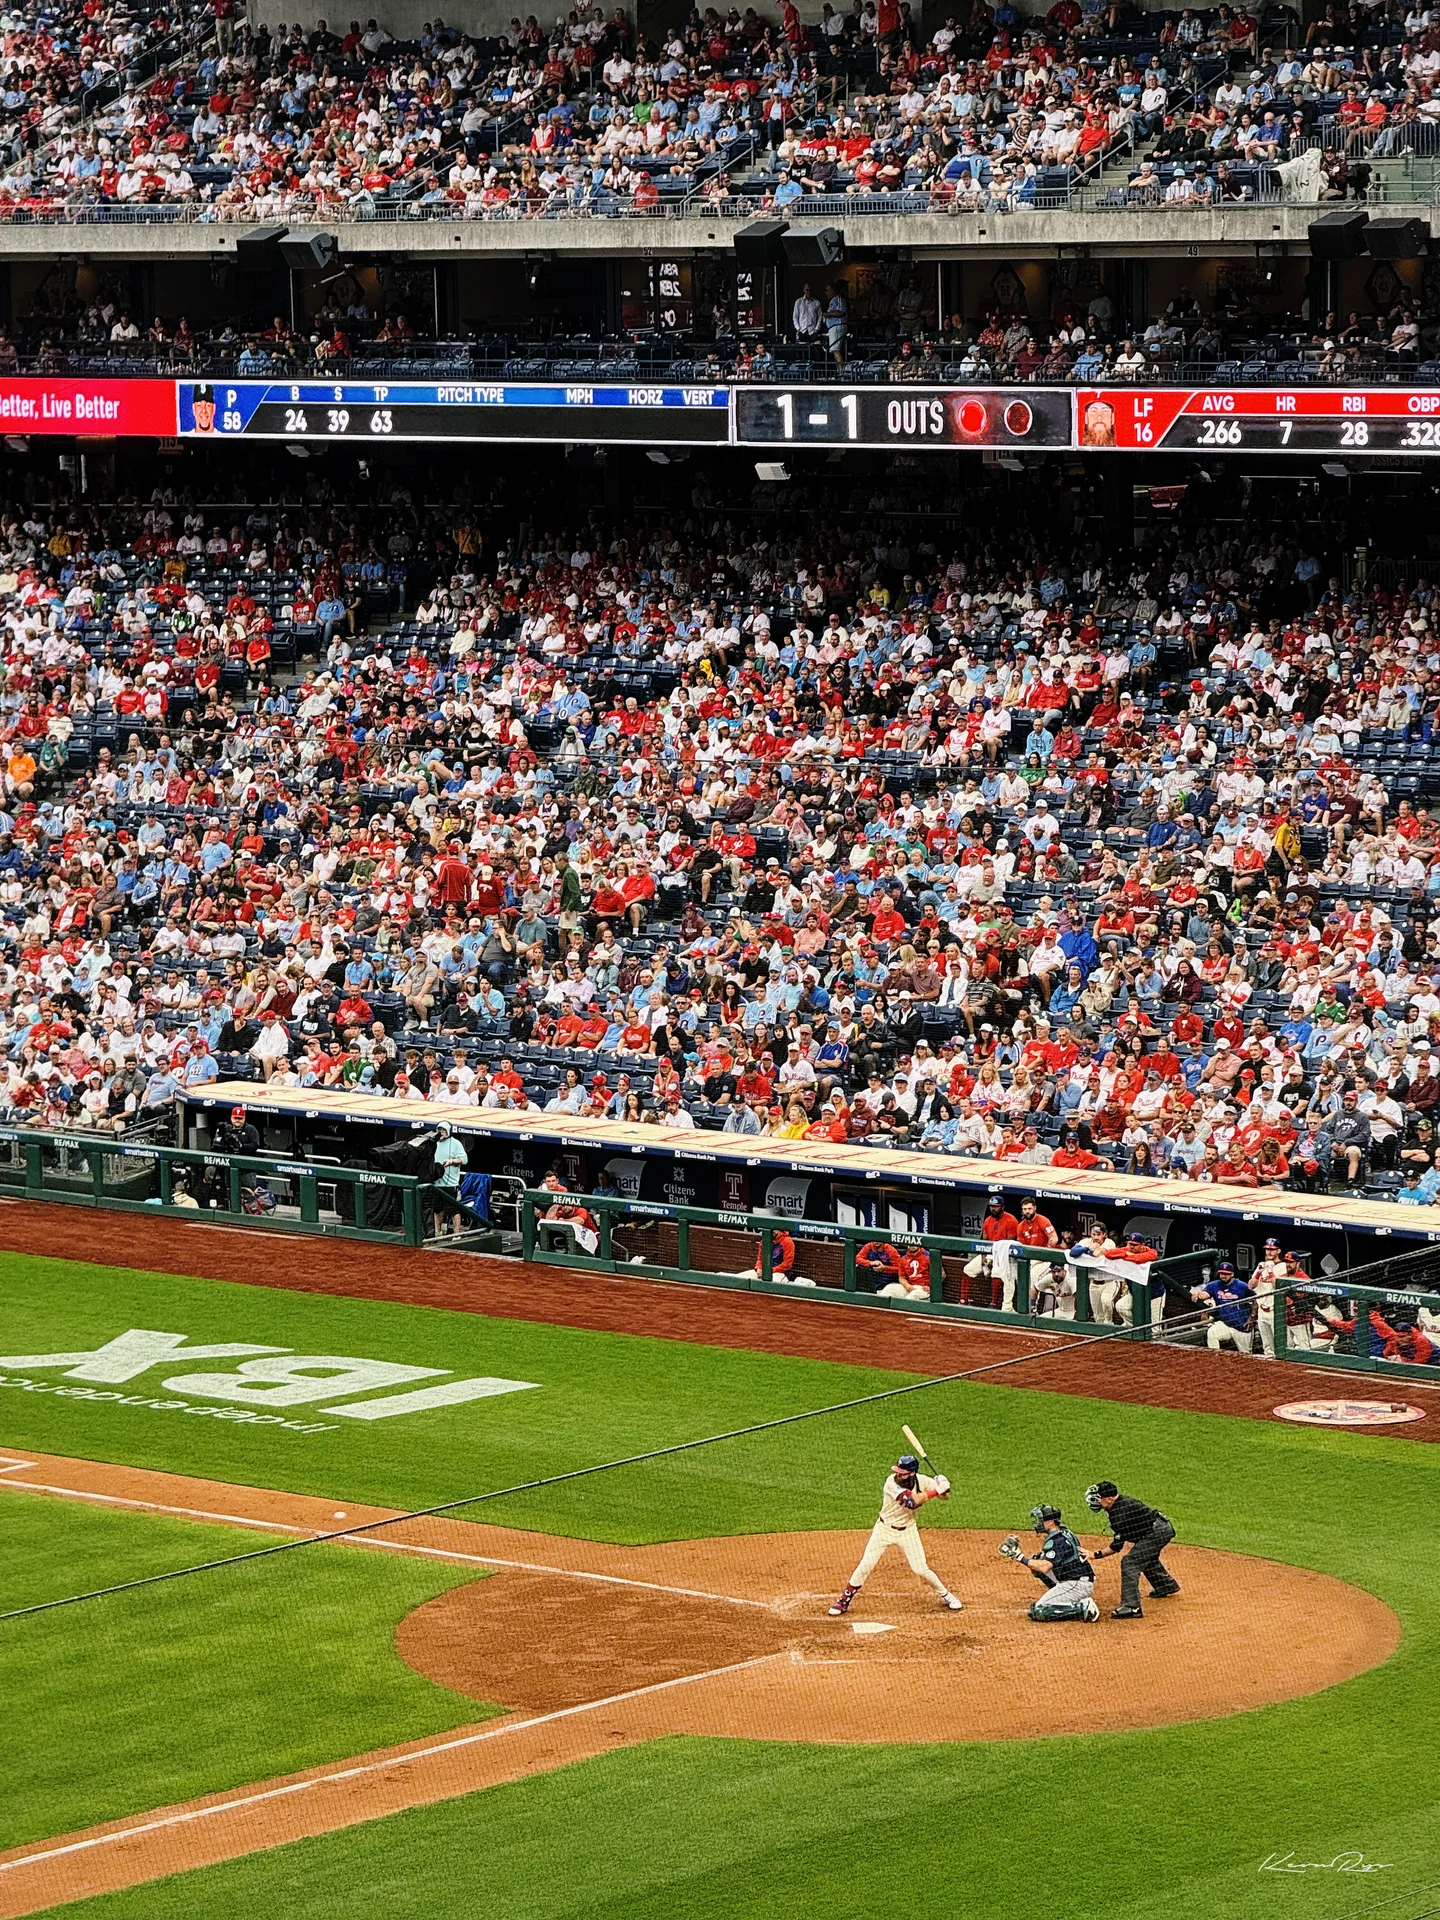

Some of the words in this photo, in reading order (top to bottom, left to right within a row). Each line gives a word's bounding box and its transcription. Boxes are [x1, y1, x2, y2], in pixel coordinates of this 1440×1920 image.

[643, 247, 652, 256] 52
[1188, 246, 1198, 256] 49
[227, 389, 237, 408] P
[291, 386, 299, 401] B
[333, 386, 342, 401] S
[374, 386, 389, 401] TP
[437, 387, 473, 402] PITCH
[475, 387, 504, 403] TYPE
[566, 388, 593, 404] MPH
[628, 389, 663, 404] HORZ
[682, 390, 715, 405] VERT
[0, 395, 38, 419] etter,
[42, 393, 72, 417] Live
[75, 394, 120, 419] Better
[1133, 397, 1153, 417] LF
[1202, 395, 1235, 411] AVG
[1275, 396, 1296, 411] HR
[1342, 396, 1366, 412] RBI
[1408, 396, 1440, 412] OBP
[223, 411, 242, 430] 58
[285, 410, 307, 431] 24
[327, 410, 349, 431] 39
[370, 410, 393, 433] 63
[776, 394, 793, 438] 1
[808, 413, 828, 425] -
[840, 394, 857, 439] 1
[887, 399, 944, 434] OUTS
[1134, 422, 1153, 442] 16
[1197, 420, 1242, 443] .266
[1279, 421, 1293, 444] 7
[1340, 421, 1369, 445] 28
[232, 543, 241, 552] P
[1315, 1035, 1327, 1047] P
[54, 1138, 79, 1149] RE/MAX
[1245, 1129, 1260, 1147] P
[204, 1156, 231, 1167] RE/MAX
[503, 1165, 534, 1178] Citizens
[359, 1174, 387, 1184] RE/MAX
[663, 1183, 696, 1196] Citizens
[1042, 1191, 1060, 1199] Citizens
[552, 1195, 581, 1206] RE/MAX
[668, 1194, 689, 1205] Bank
[721, 1200, 748, 1211] Temple
[767, 1195, 803, 1210] smart
[629, 1204, 664, 1215] smartwater
[787, 1207, 803, 1216] water
[718, 1213, 748, 1225] RE/MAX
[1301, 1219, 1320, 1227] Citizens
[798, 1224, 835, 1235] smartwater
[891, 1233, 922, 1245] RE/MAX
[1386, 1292, 1422, 1306] RE/MAX
[0, 1328, 543, 1420] IBX
[0, 1375, 339, 1434] Independenc
